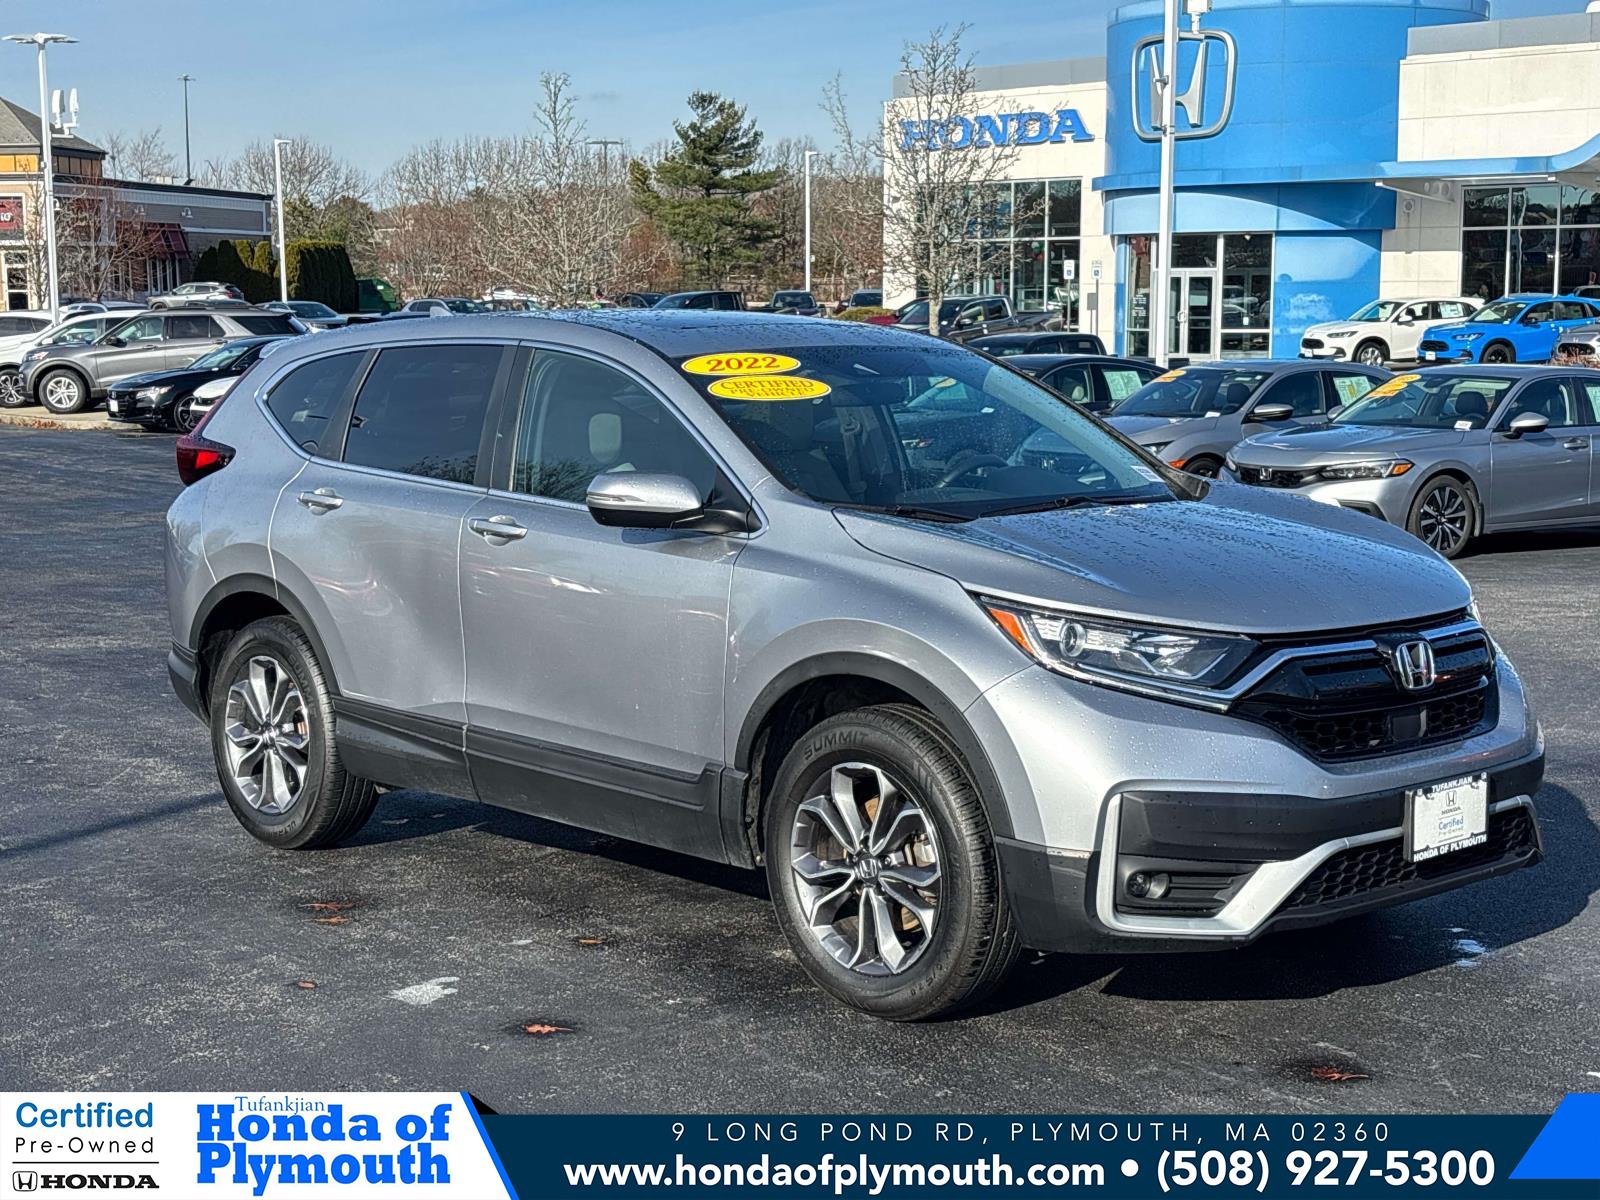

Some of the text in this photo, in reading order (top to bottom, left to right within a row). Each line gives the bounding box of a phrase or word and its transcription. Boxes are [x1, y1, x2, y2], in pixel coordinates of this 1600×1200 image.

[900, 108, 1095, 152] HONDA
[706, 356, 781, 372] 2022
[720, 380, 815, 391] CERTIFIED
[804, 730, 869, 760] SUMMIT
[1431, 776, 1473, 793] TUFANKJIAN
[1439, 816, 1464, 831] Certified
[1413, 834, 1487, 862] HONDA OF PLYMOUTH
